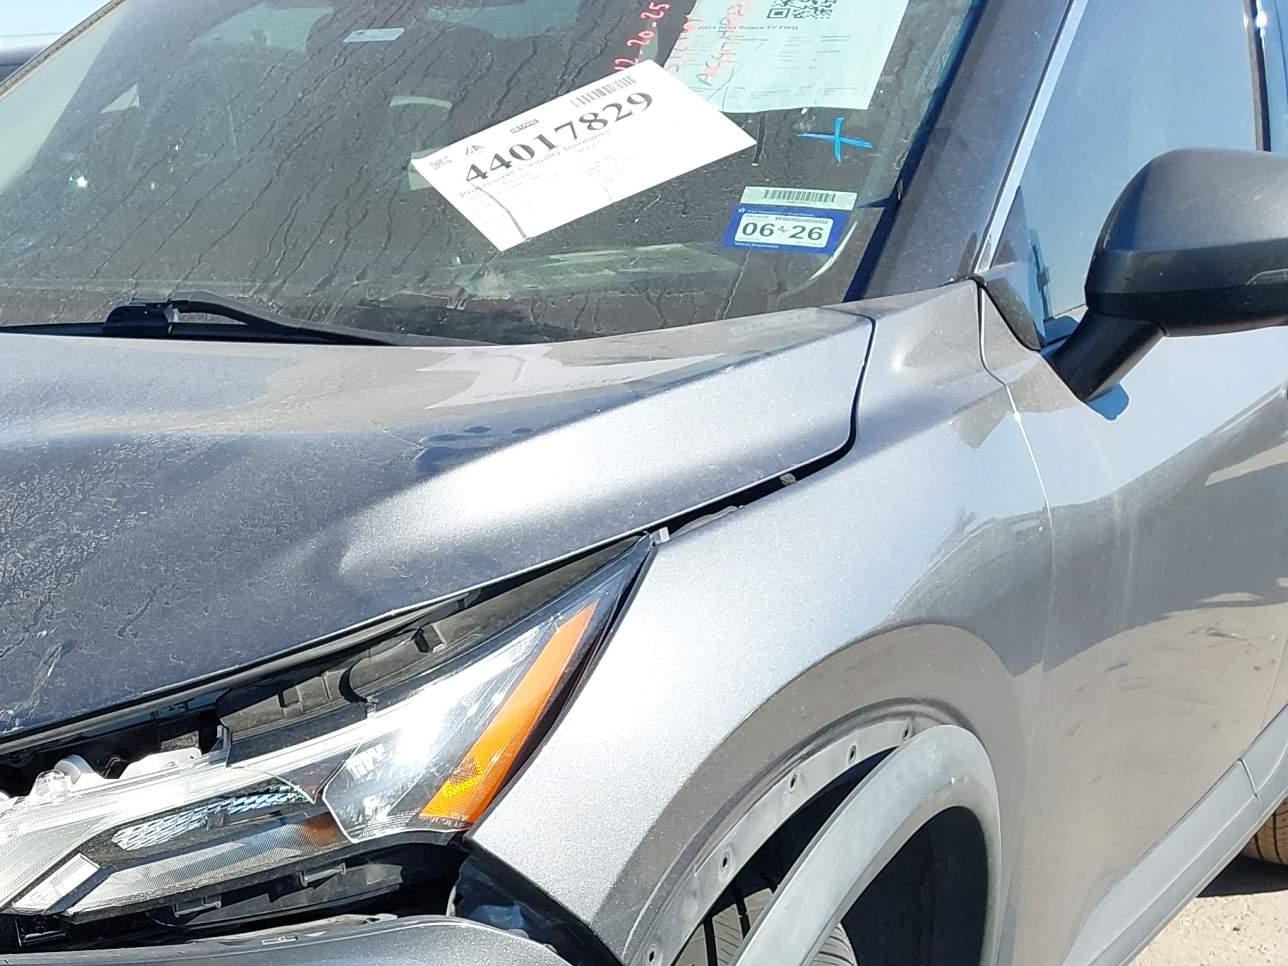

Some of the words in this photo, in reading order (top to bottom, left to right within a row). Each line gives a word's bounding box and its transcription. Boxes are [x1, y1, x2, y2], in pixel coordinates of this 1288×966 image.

[466, 92, 653, 182] 44017829
[742, 222, 775, 237] 06
[788, 225, 824, 241] 26
